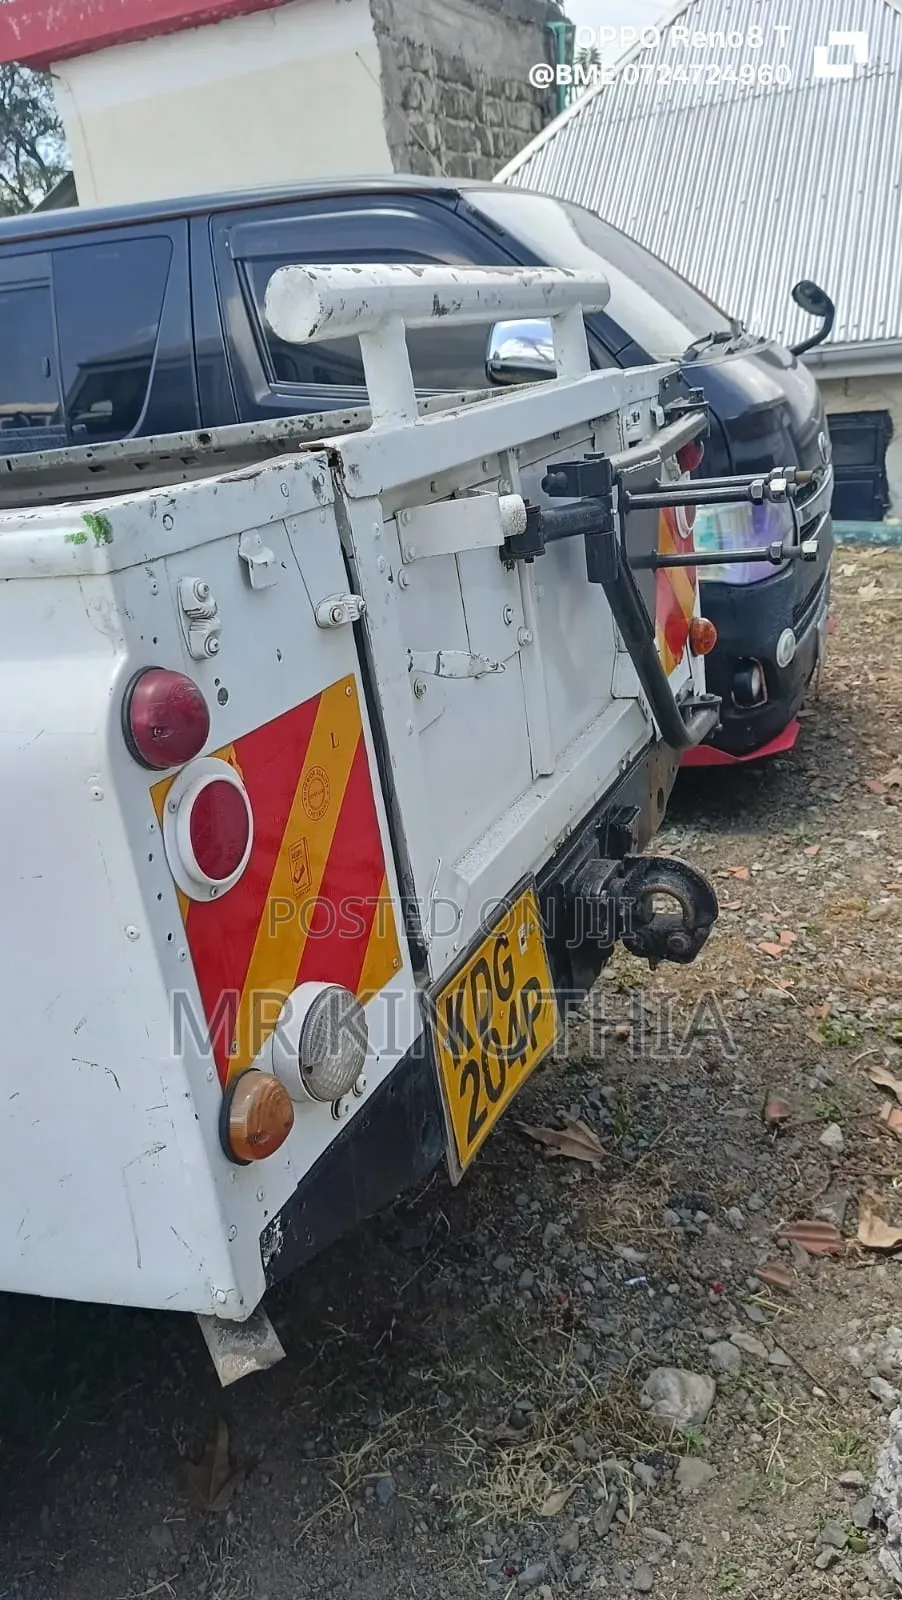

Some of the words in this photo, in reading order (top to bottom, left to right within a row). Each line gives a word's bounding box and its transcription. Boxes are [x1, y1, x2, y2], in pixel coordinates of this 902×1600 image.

[330, 732, 340, 749] L
[444, 931, 515, 1070] KDG
[460, 976, 542, 1146] 204P
